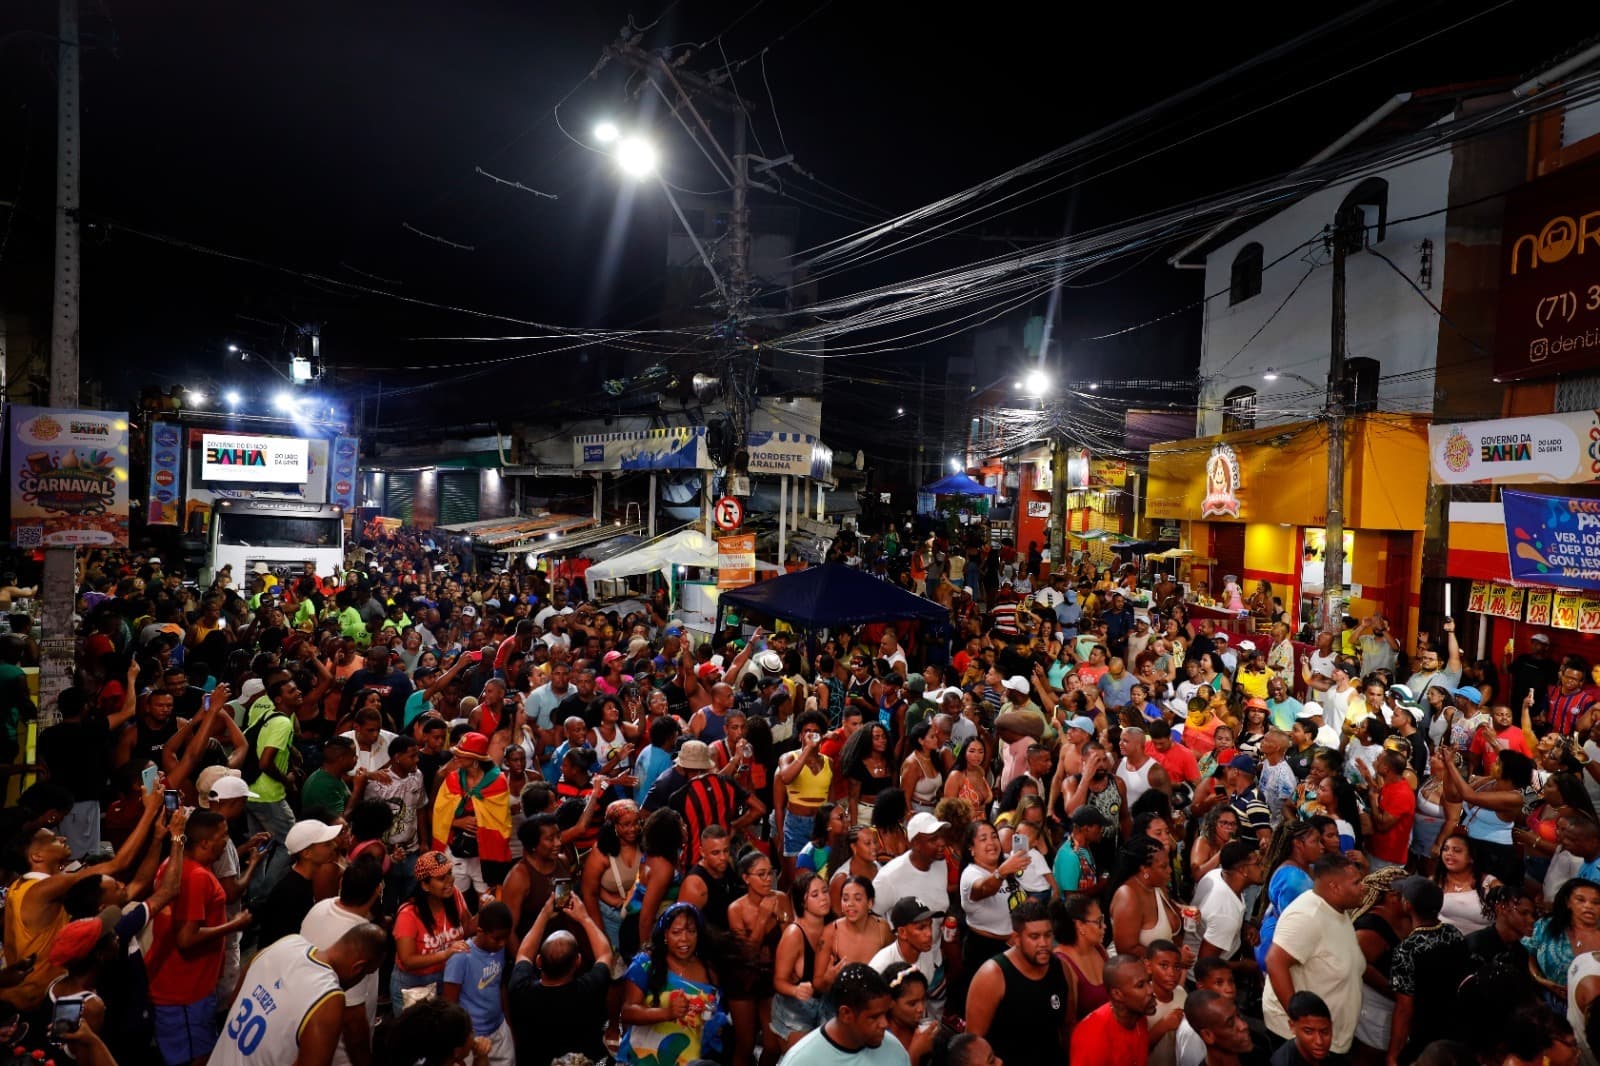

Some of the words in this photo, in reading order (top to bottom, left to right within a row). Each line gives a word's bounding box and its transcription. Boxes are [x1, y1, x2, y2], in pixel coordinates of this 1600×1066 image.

[1535, 291, 1577, 328] (71)
[1481, 435, 1518, 445] GOVERNO
[1520, 434, 1532, 442] DA
[206, 448, 267, 467] BAHIA
[753, 452, 805, 462] NORDESTE
[1482, 444, 1532, 462] BAHIA
[25, 478, 111, 495] CARNAVAL
[1554, 532, 1580, 543] VER.
[1559, 544, 1584, 556] DEP.
[1549, 555, 1579, 567] GOV.
[252, 984, 277, 1016] CURRY
[228, 997, 267, 1056] 30
